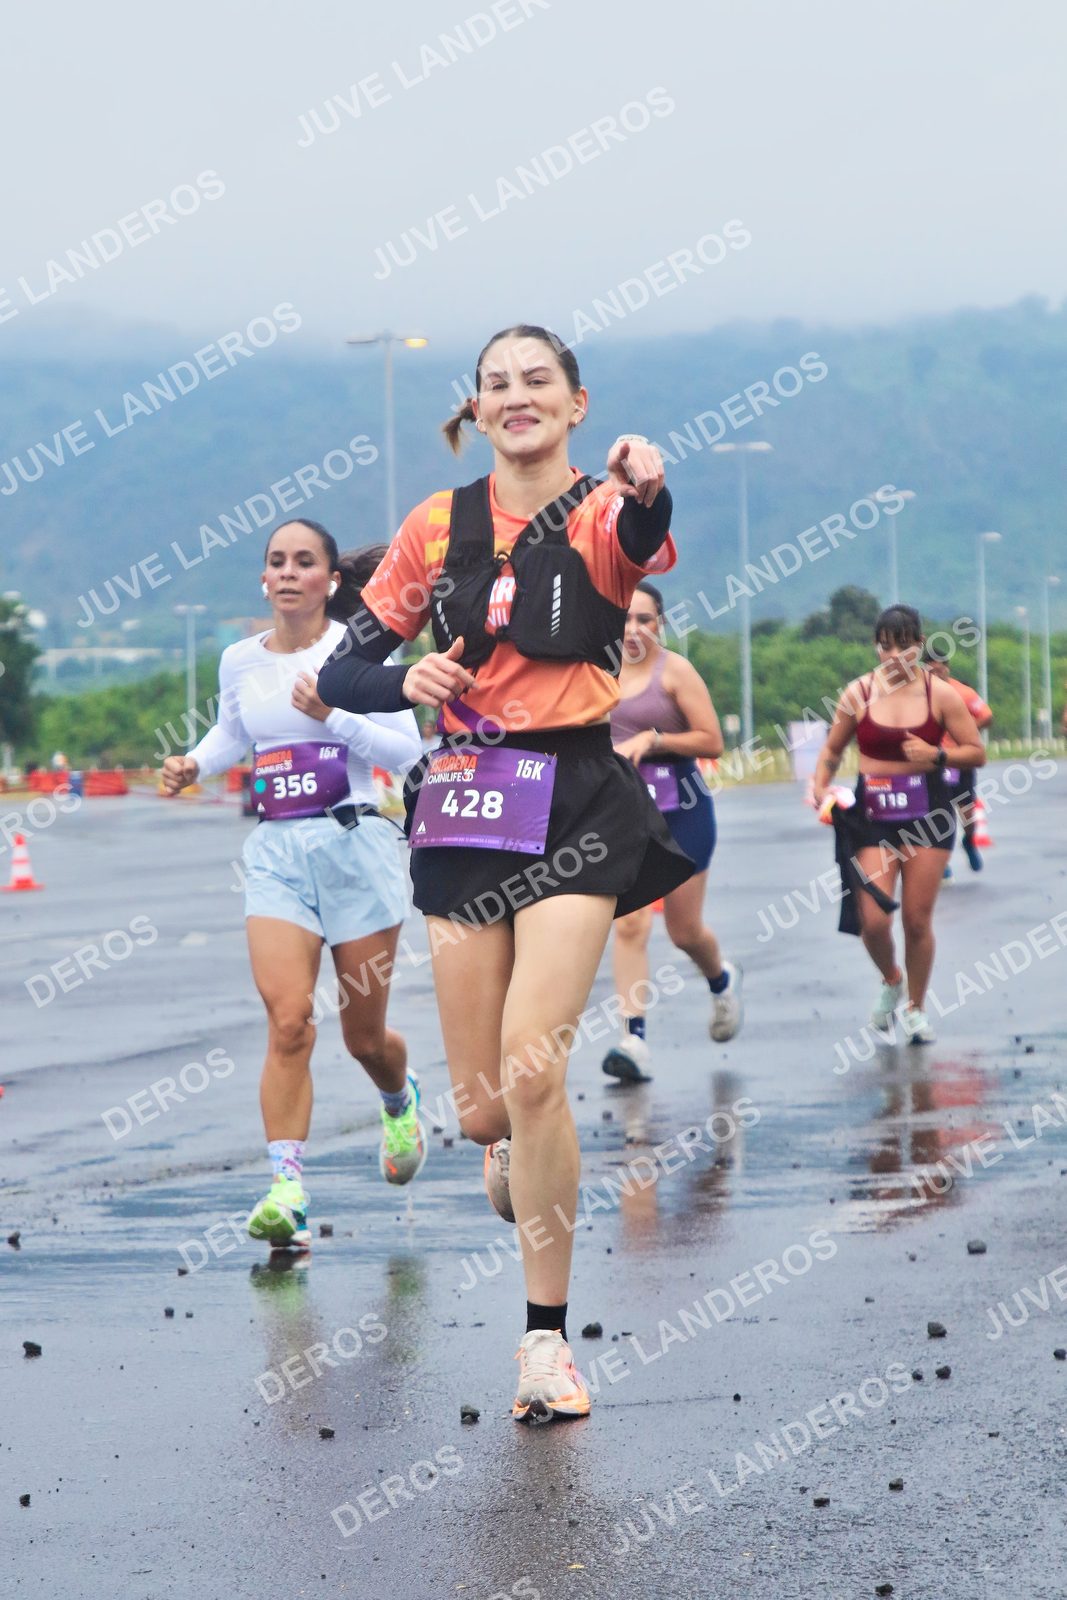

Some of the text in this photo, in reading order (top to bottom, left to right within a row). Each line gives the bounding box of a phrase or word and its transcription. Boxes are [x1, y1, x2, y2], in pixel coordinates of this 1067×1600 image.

[515, 758, 546, 781] 15K
[273, 772, 318, 800] 356
[441, 789, 504, 819] 428
[878, 792, 908, 809] 118
